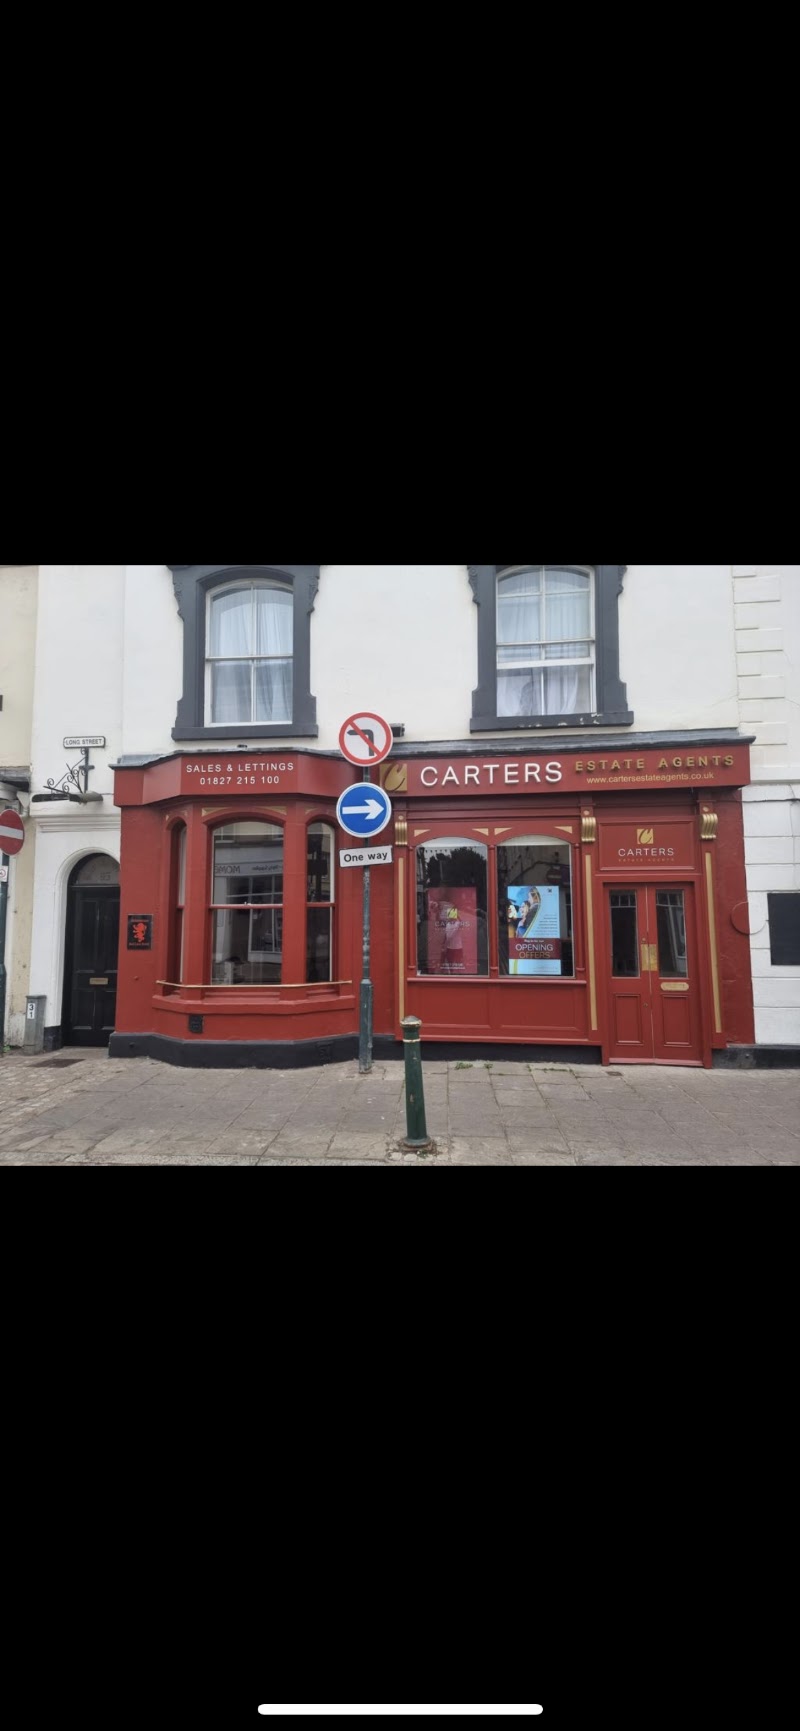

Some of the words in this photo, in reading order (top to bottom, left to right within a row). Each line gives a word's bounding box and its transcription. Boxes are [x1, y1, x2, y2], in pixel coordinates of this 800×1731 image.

[186, 764, 222, 773] SALES
[226, 764, 233, 772] &
[238, 762, 294, 772] LETTINGS
[575, 758, 645, 771] ESTATE
[658, 755, 734, 768] AGENTS
[420, 761, 563, 786] CARTERS
[586, 771, 714, 784] www.cartersestateagents.co.uk
[200, 777, 231, 785] 01827
[237, 776, 255, 785] 215
[261, 776, 279, 784] 100
[343, 853, 364, 862] One
[367, 852, 388, 861] way
[618, 848, 674, 857] CARTERS
